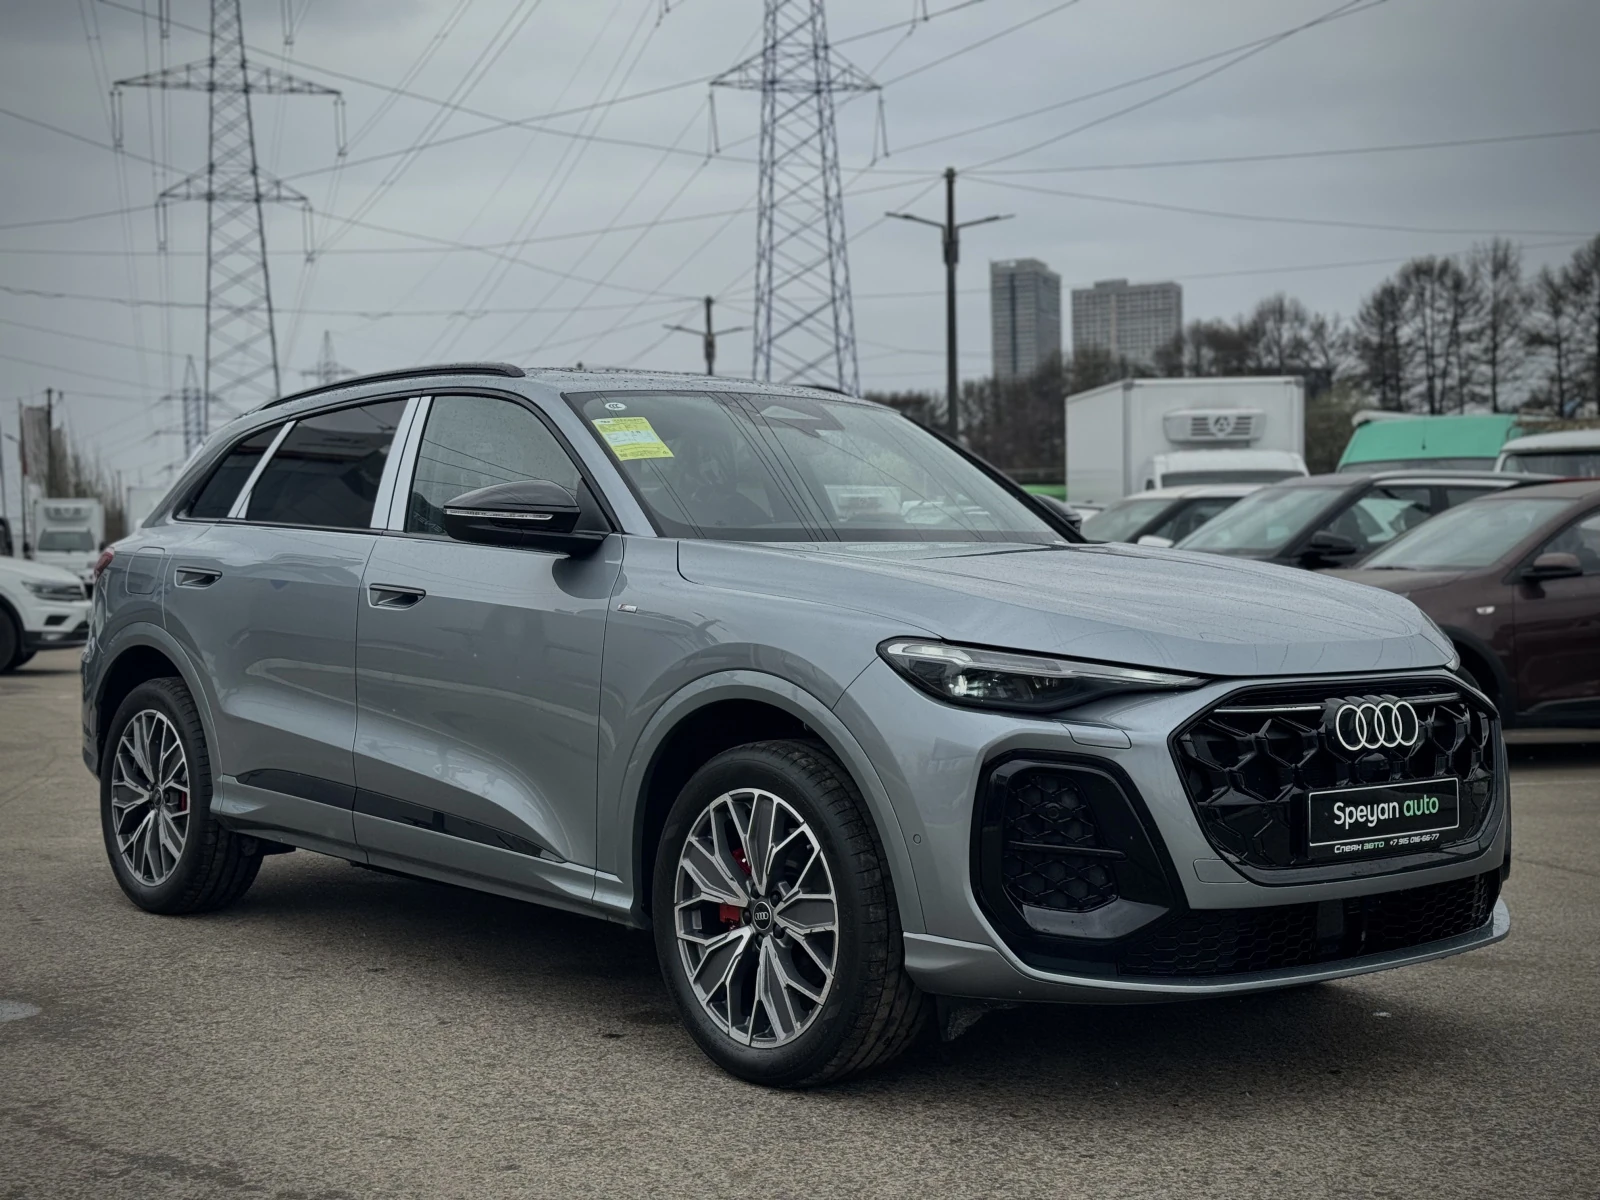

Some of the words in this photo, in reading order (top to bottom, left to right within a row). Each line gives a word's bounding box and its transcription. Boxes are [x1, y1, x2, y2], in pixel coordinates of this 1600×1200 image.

[1333, 801, 1400, 830] Speyan
[1403, 794, 1440, 817] auto
[1389, 838, 1398, 846] +7
